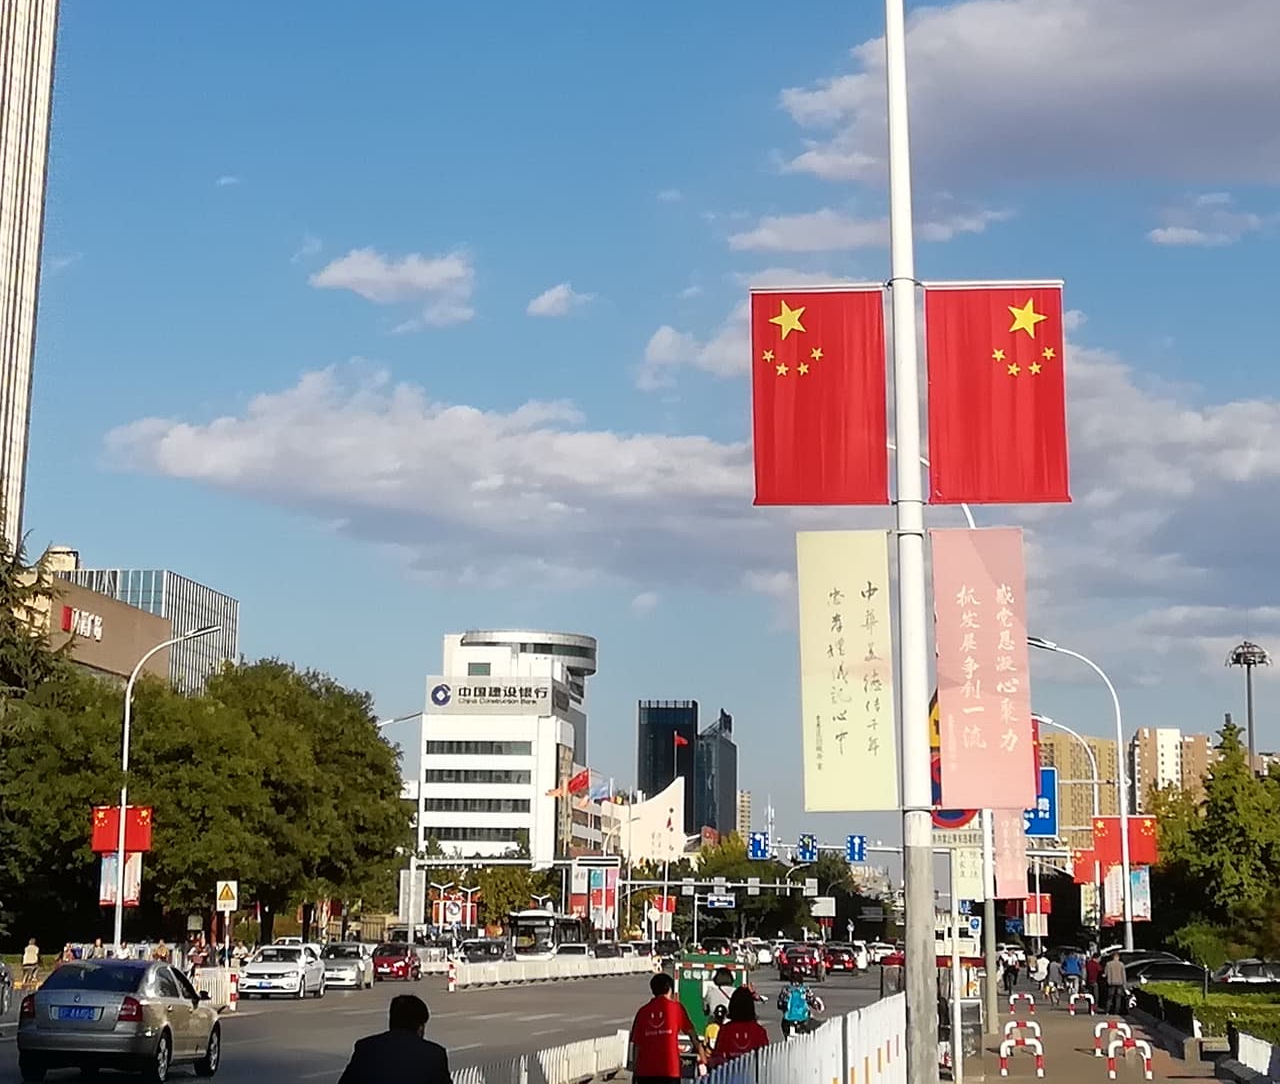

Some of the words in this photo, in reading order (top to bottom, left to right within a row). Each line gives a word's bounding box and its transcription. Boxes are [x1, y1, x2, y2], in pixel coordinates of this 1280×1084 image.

[458, 686, 549, 699] 中国建设银行
